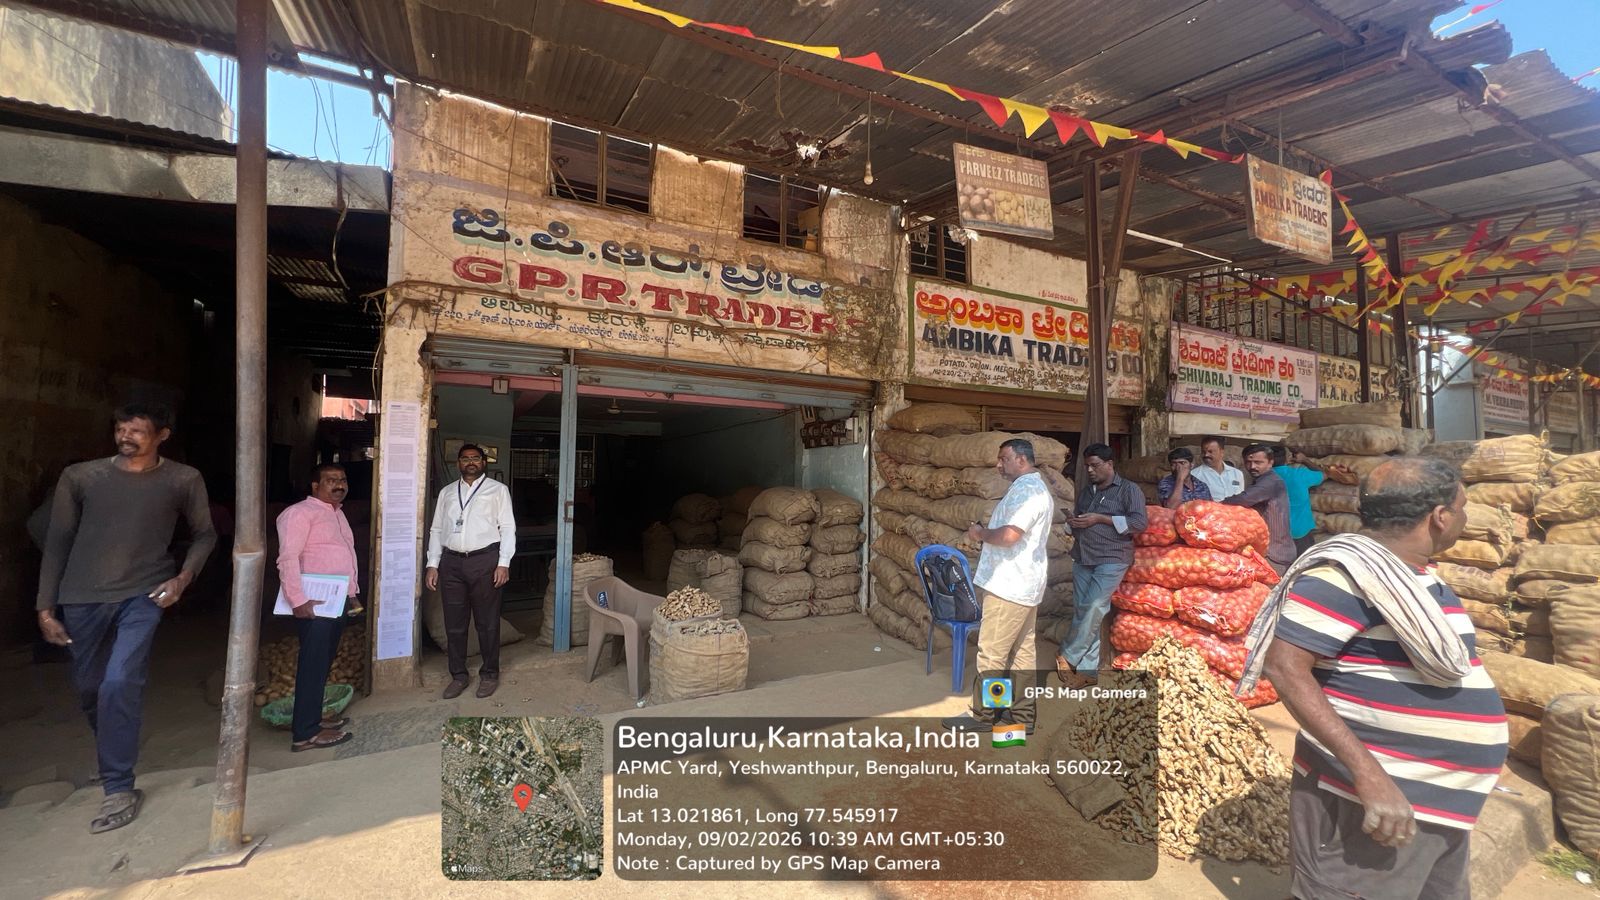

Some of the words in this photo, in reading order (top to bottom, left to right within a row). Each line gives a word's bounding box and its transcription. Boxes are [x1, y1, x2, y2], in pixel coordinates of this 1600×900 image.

[960, 160, 1002, 181] PARVEEZ
[1004, 168, 1046, 189] TRADERS
[1292, 200, 1328, 228] TRADERS
[916, 291, 1024, 334] ಅಂಬಿಕಾ
[922, 323, 1013, 358] AMBIKA
[1179, 367, 1233, 388] SHIVARAJ
[1240, 376, 1282, 395] TRADING
[1288, 384, 1304, 399] CO.
